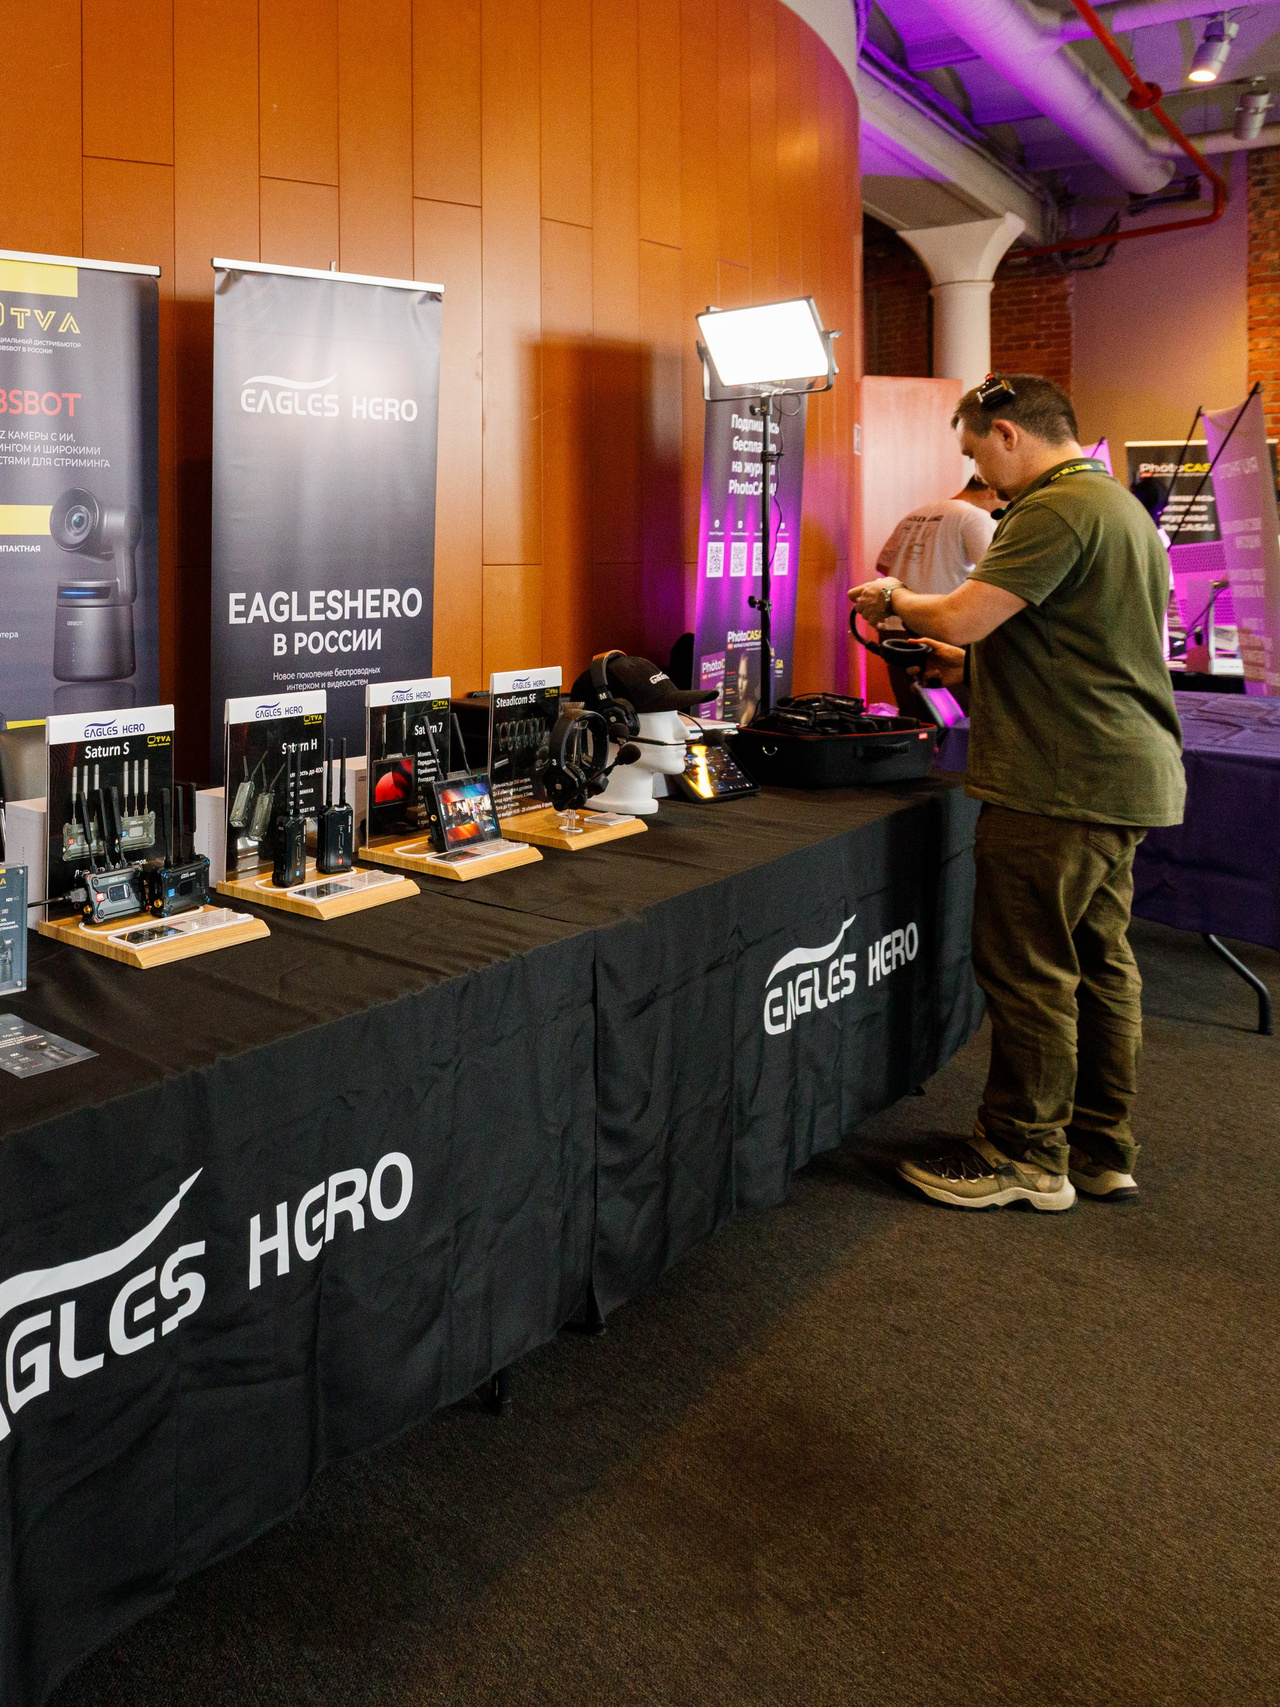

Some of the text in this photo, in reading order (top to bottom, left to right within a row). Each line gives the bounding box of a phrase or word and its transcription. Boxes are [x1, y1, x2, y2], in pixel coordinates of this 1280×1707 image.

[10, 307, 81, 334] TVA
[240, 388, 418, 422] EAGLES HERO
[731, 413, 780, 434] Подпишсь
[8, 430, 49, 441] КАМЕРЫ
[50, 432, 57, 441] С
[33, 444, 41, 453] И
[43, 445, 101, 455] ШИРОКИМИ
[732, 435, 777, 453] бесплао
[32, 456, 52, 467] ДЛЯ
[54, 457, 111, 468] СТРИМИНГА
[731, 461, 776, 477] на журл
[1139, 462, 1212, 473] PhotoCAS
[228, 587, 422, 625] EAGLESHERO
[273, 628, 382, 656] В РОССИИ
[273, 667, 381, 680] Новое поколение беспроводных
[701, 658, 726, 674] PhotoC
[286, 682, 320, 691] интерком
[496, 693, 537, 708] Steadicom SE
[599, 692, 608, 701] M
[255, 705, 304, 719] EAGLES HERO
[83, 723, 146, 738] EAGLES HERO
[414, 722, 444, 736] Satrn 7
[155, 735, 171, 743] TVA
[311, 738, 318, 750] H
[84, 741, 130, 759] Saturn S
[551, 758, 557, 766] 3
[763, 921, 919, 1036] EAGLES HERO
[248, 1151, 414, 1290] HERO
